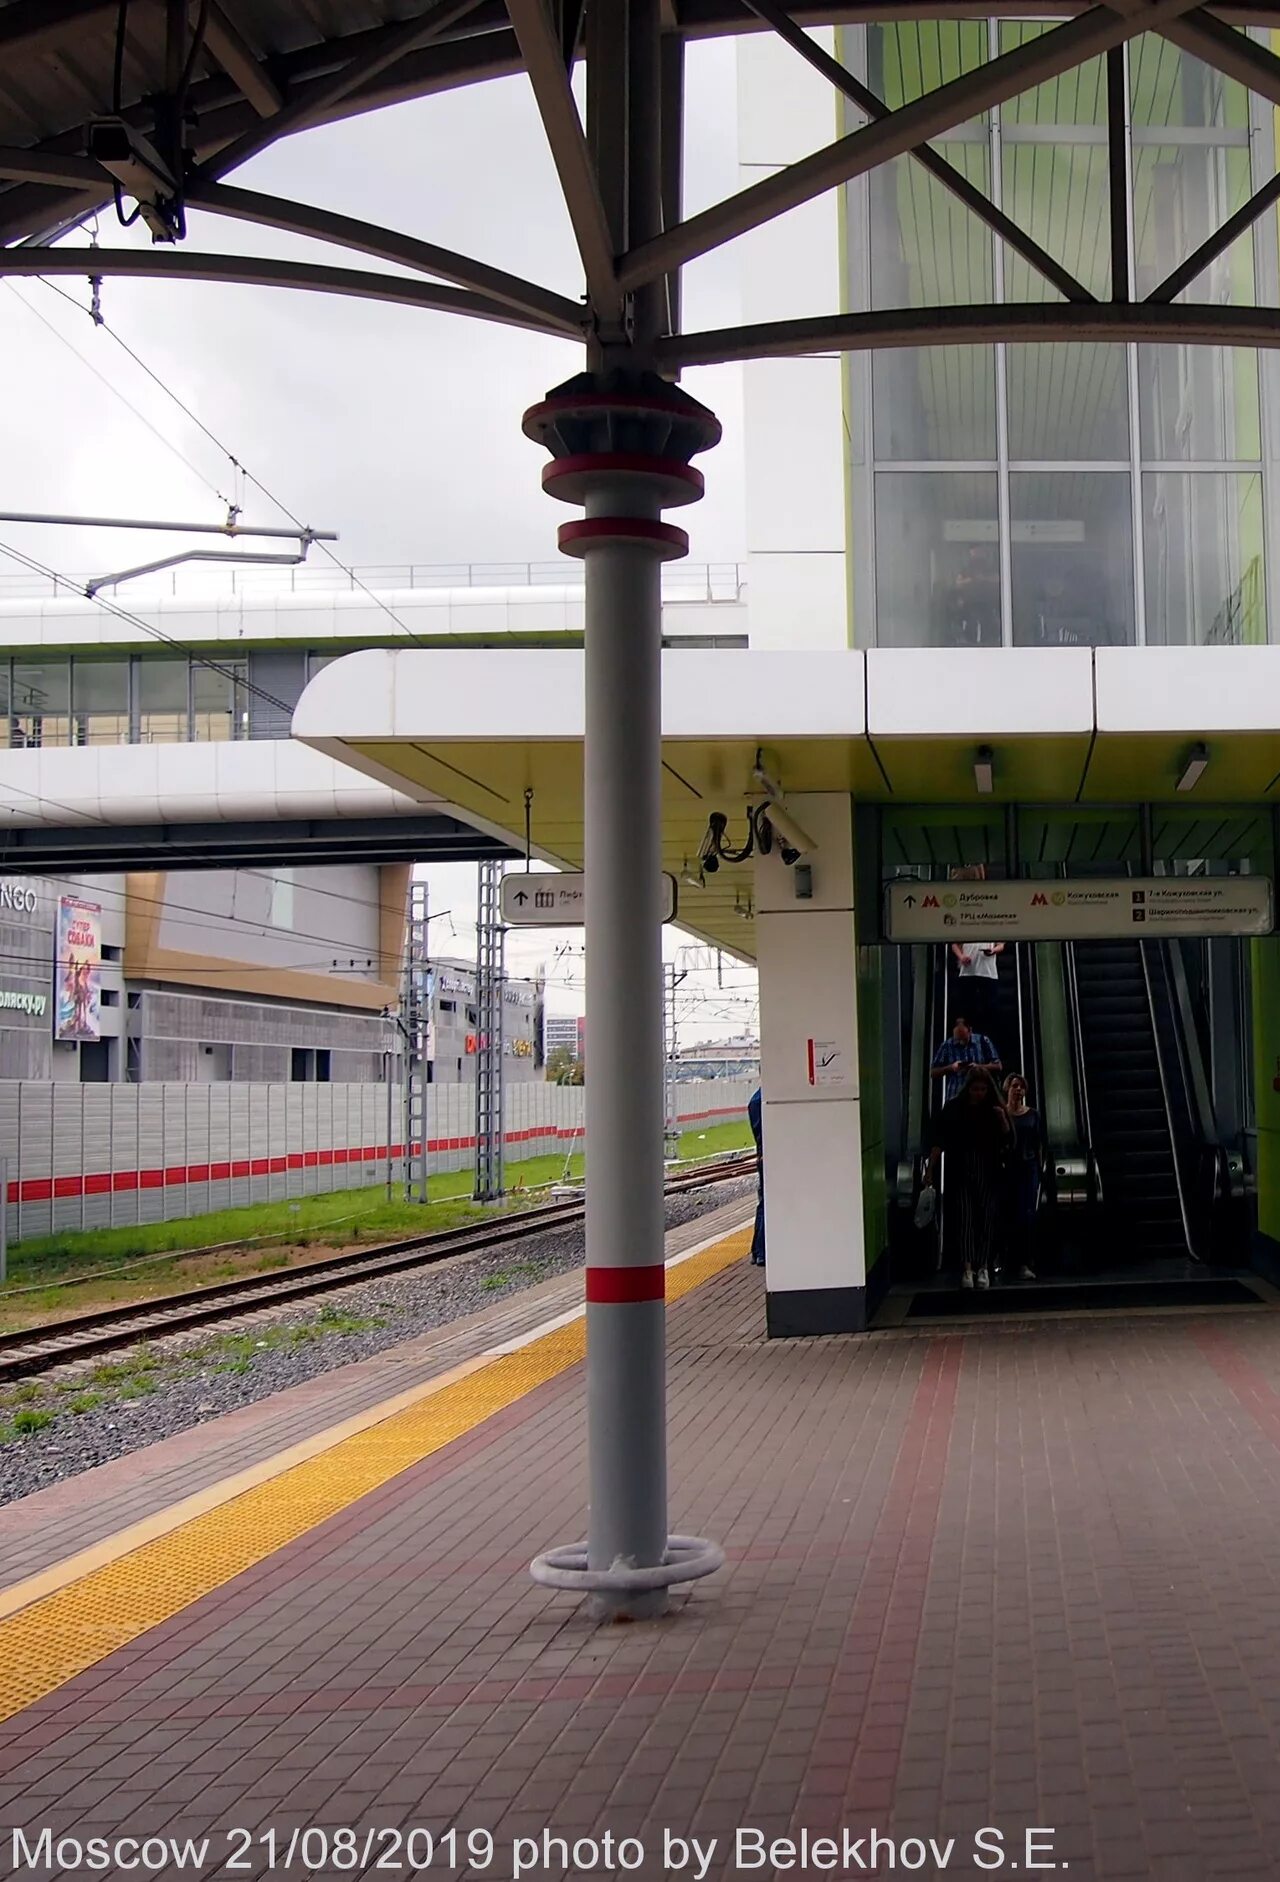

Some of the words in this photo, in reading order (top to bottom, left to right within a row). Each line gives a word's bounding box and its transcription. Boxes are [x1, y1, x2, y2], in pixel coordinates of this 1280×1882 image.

[959, 892, 998, 902] Дубровка
[1067, 891, 1119, 899] Кожуховская
[1161, 890, 1212, 898] Кожуховская
